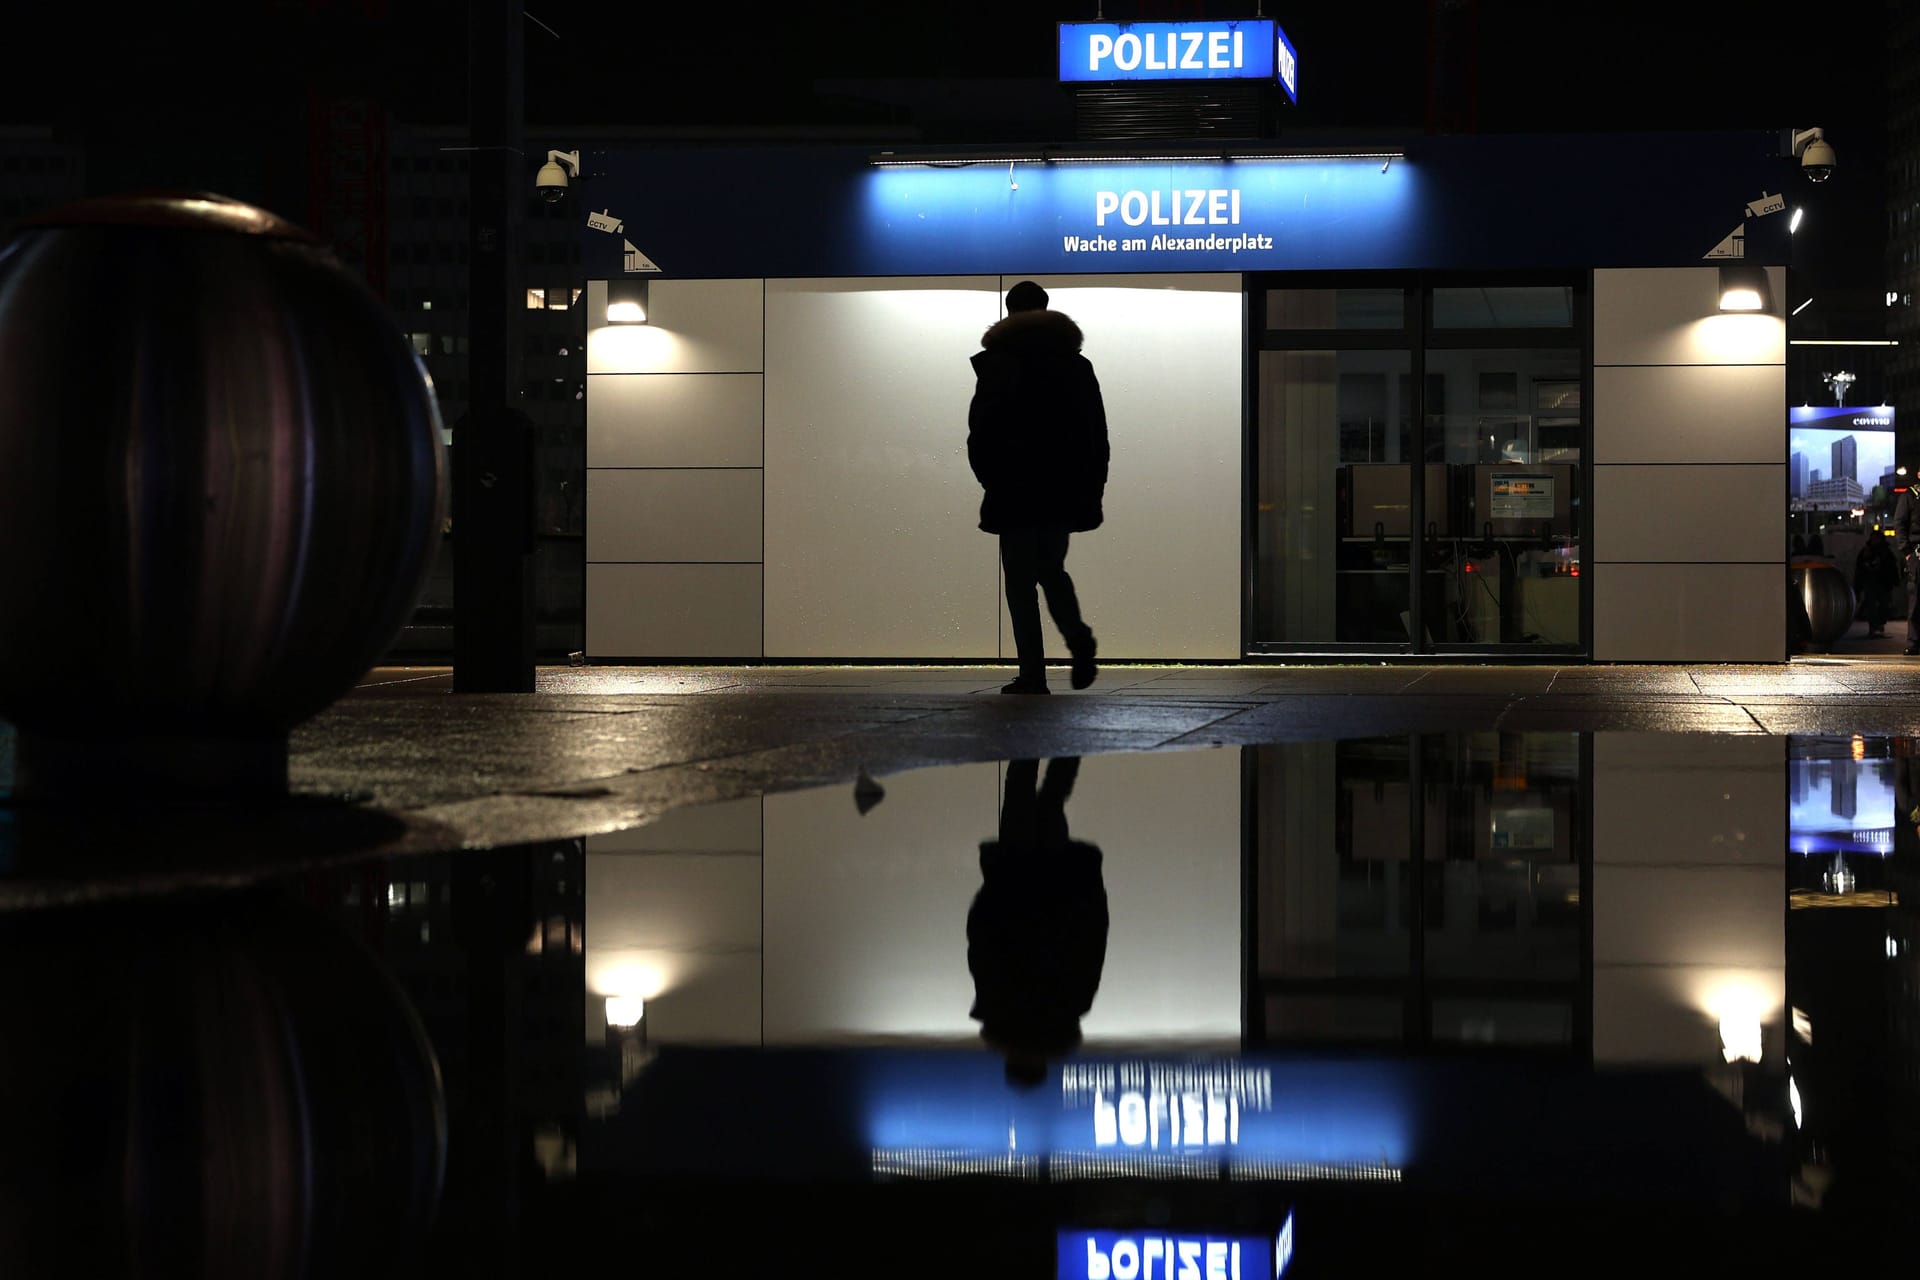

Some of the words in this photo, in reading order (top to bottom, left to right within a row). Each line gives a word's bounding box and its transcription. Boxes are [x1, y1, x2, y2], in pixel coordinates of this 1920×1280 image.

[1089, 31, 1243, 71] POLIZEI
[1096, 189, 1241, 227] POLIZEI
[1763, 202, 1783, 213] CCTV
[589, 220, 608, 230] CCTV
[1063, 235, 1117, 252] Wache
[1121, 238, 1147, 251] am
[1151, 233, 1273, 254] Alexanderplatz
